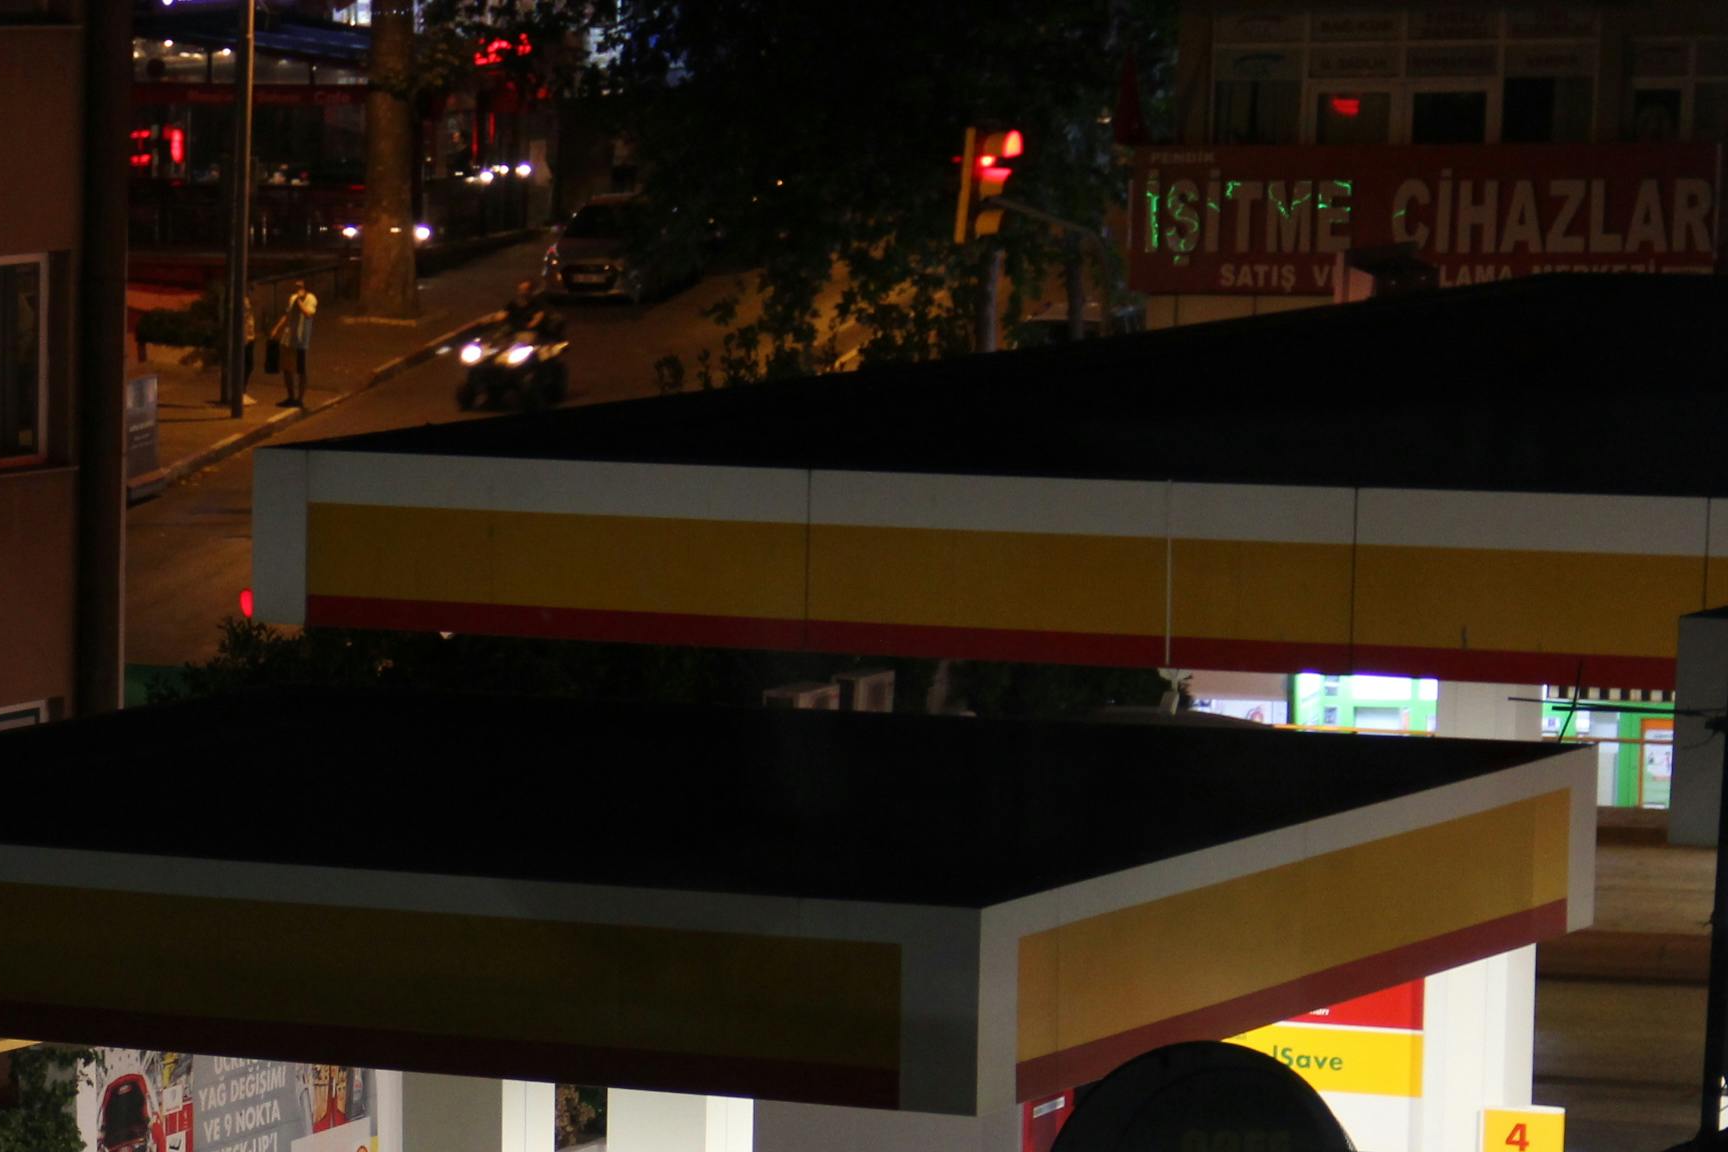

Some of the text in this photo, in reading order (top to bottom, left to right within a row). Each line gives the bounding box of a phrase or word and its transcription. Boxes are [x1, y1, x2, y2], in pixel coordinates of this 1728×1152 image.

[1144, 168, 1354, 266] İŞİTME
[1219, 263, 1297, 292] SATIŞ
[1312, 263, 1335, 287] V
[1438, 264, 1513, 288] LAMA
[1272, 1044, 1344, 1071] lSave
[198, 1075, 226, 1112] YAĞ
[204, 1098, 282, 1143] VE 9 NOKTA
[1505, 1122, 1530, 1152] 4
